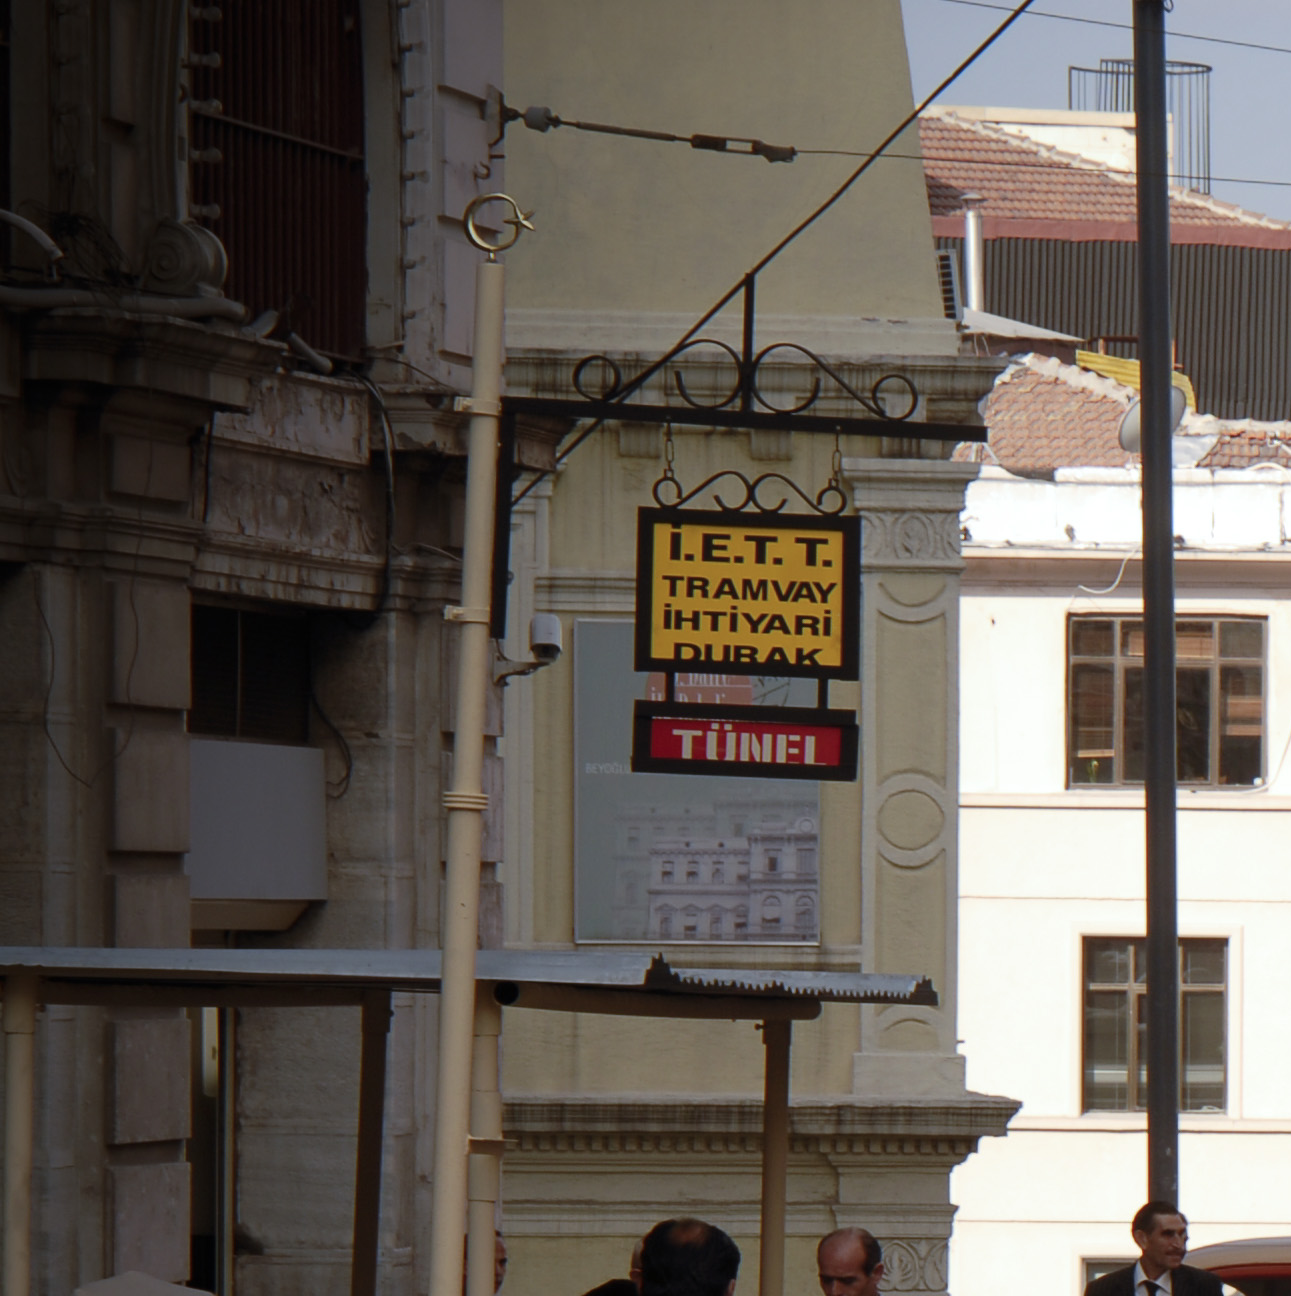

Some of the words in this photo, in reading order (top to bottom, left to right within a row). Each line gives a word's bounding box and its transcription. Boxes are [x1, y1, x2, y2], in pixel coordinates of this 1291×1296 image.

[661, 575, 838, 604] TRAMVAY
[662, 603, 832, 637] İHTİYARİ
[672, 723, 827, 765] TÜNEL
